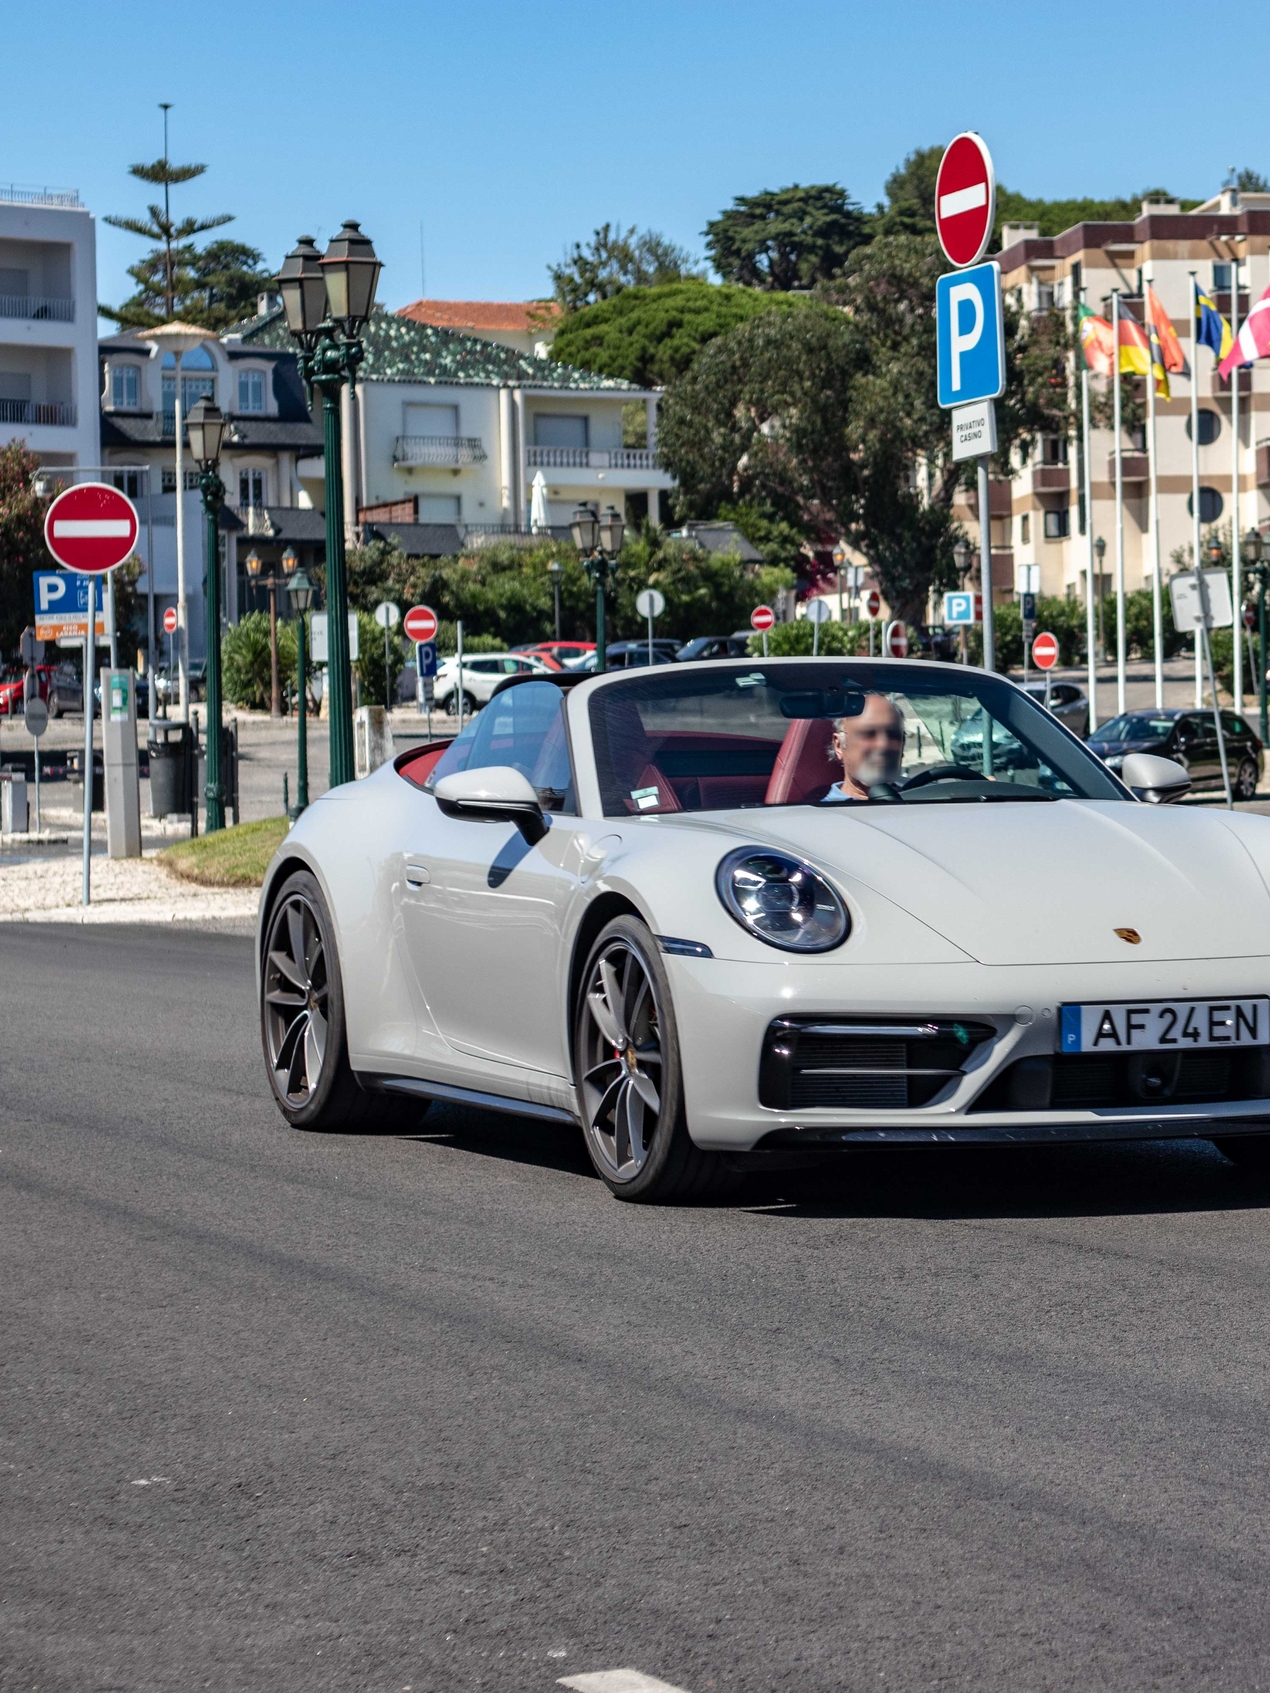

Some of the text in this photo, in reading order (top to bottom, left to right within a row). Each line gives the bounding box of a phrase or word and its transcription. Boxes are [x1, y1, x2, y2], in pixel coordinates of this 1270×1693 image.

[950, 282, 985, 392] P
[956, 417, 985, 434] PRIVATIVO
[959, 430, 982, 443] CASINO
[39, 575, 66, 611] P
[951, 598, 967, 619] P
[421, 646, 433, 674] P
[1092, 1003, 1259, 1047] AF 24 EN
